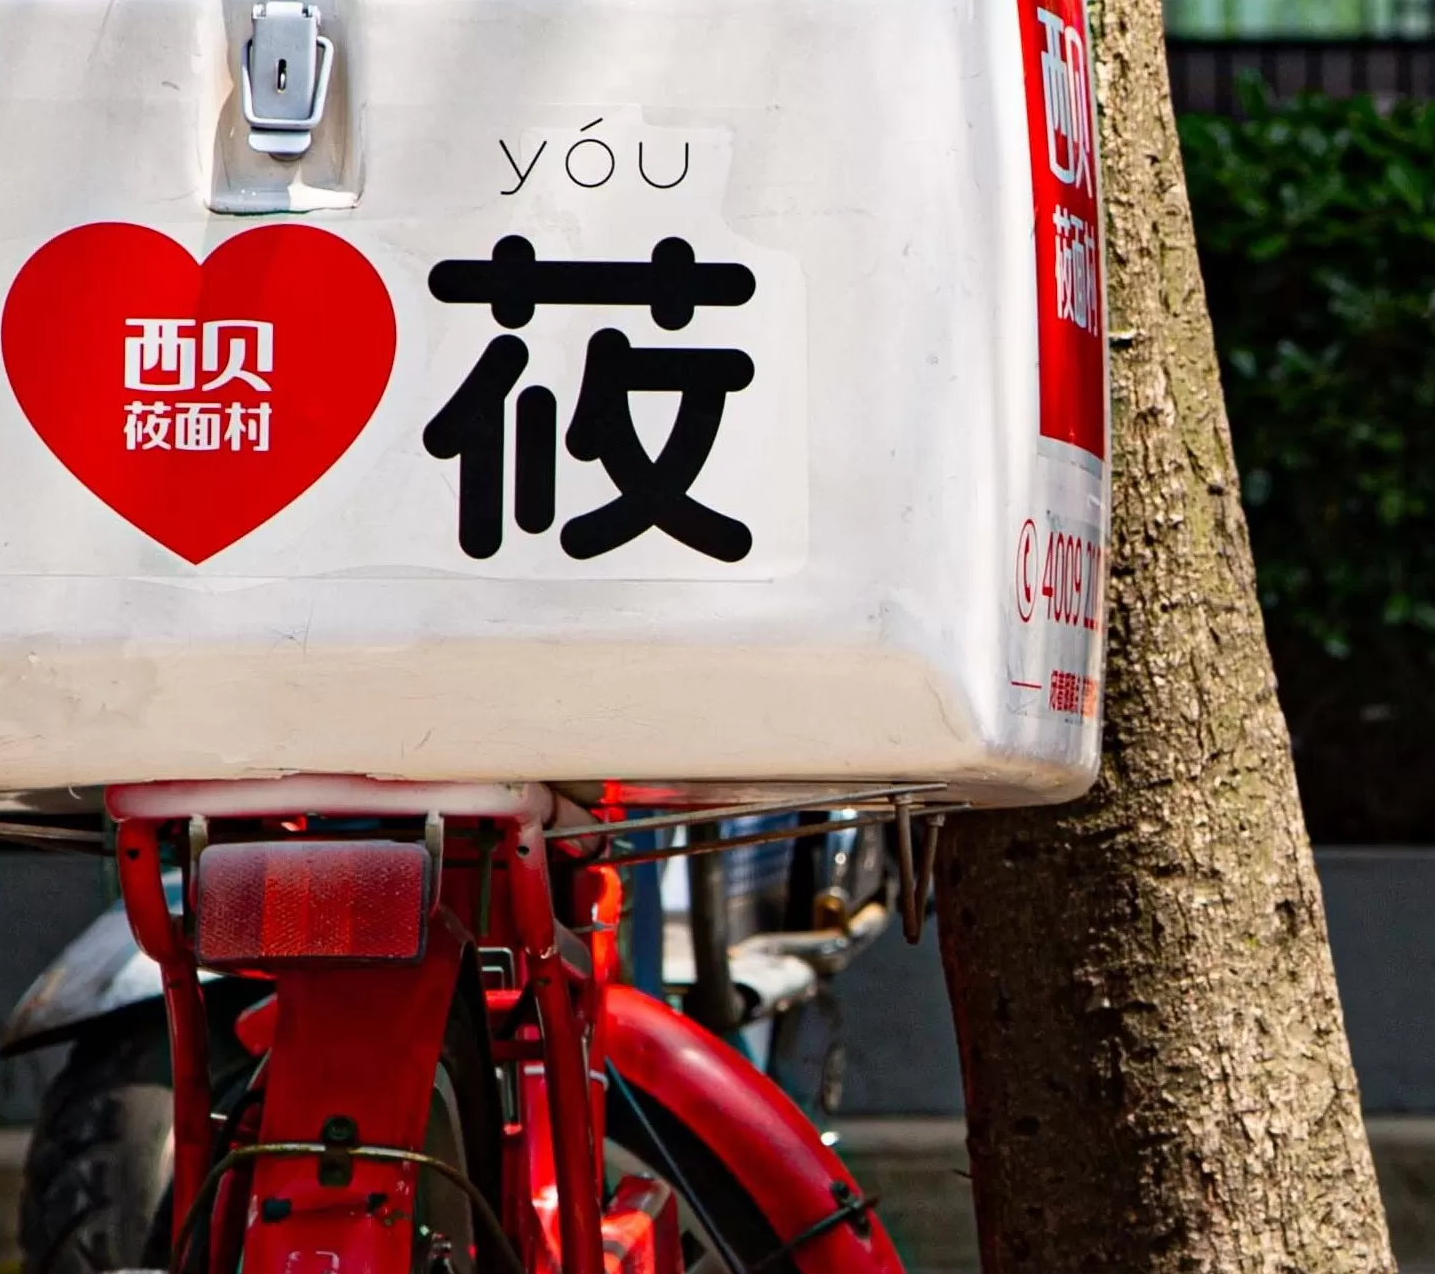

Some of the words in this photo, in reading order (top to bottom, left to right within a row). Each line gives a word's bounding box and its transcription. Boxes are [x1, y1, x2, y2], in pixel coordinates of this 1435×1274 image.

[498, 116, 690, 197] yóu
[122, 317, 275, 393] 西贝
[122, 399, 273, 453] 莜面村
[421, 233, 757, 564] 莜
[1042, 530, 1083, 627] 4009
